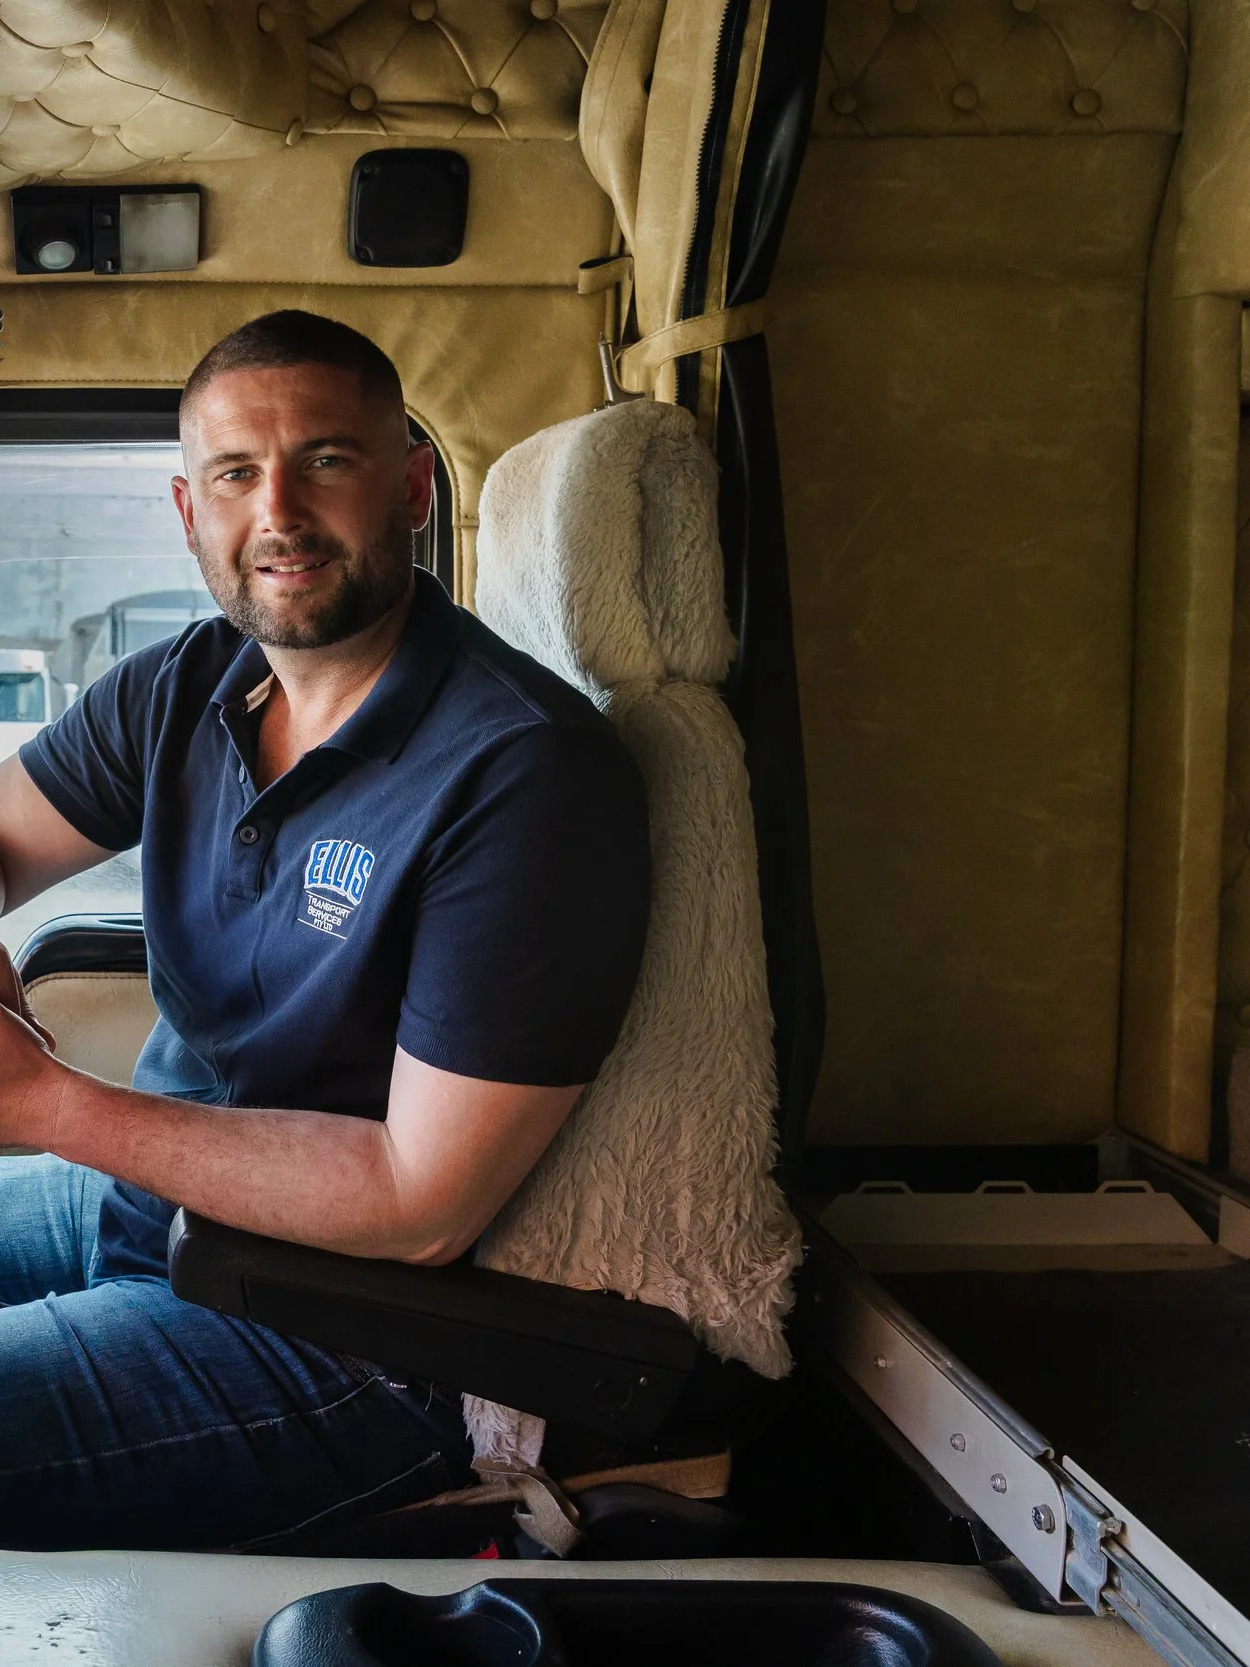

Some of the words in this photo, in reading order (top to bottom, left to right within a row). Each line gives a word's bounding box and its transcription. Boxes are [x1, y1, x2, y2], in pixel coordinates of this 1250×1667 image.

[304, 840, 375, 906] ELLIS
[307, 906, 342, 926] SERVICES
[308, 895, 351, 918] TRANSPORT
